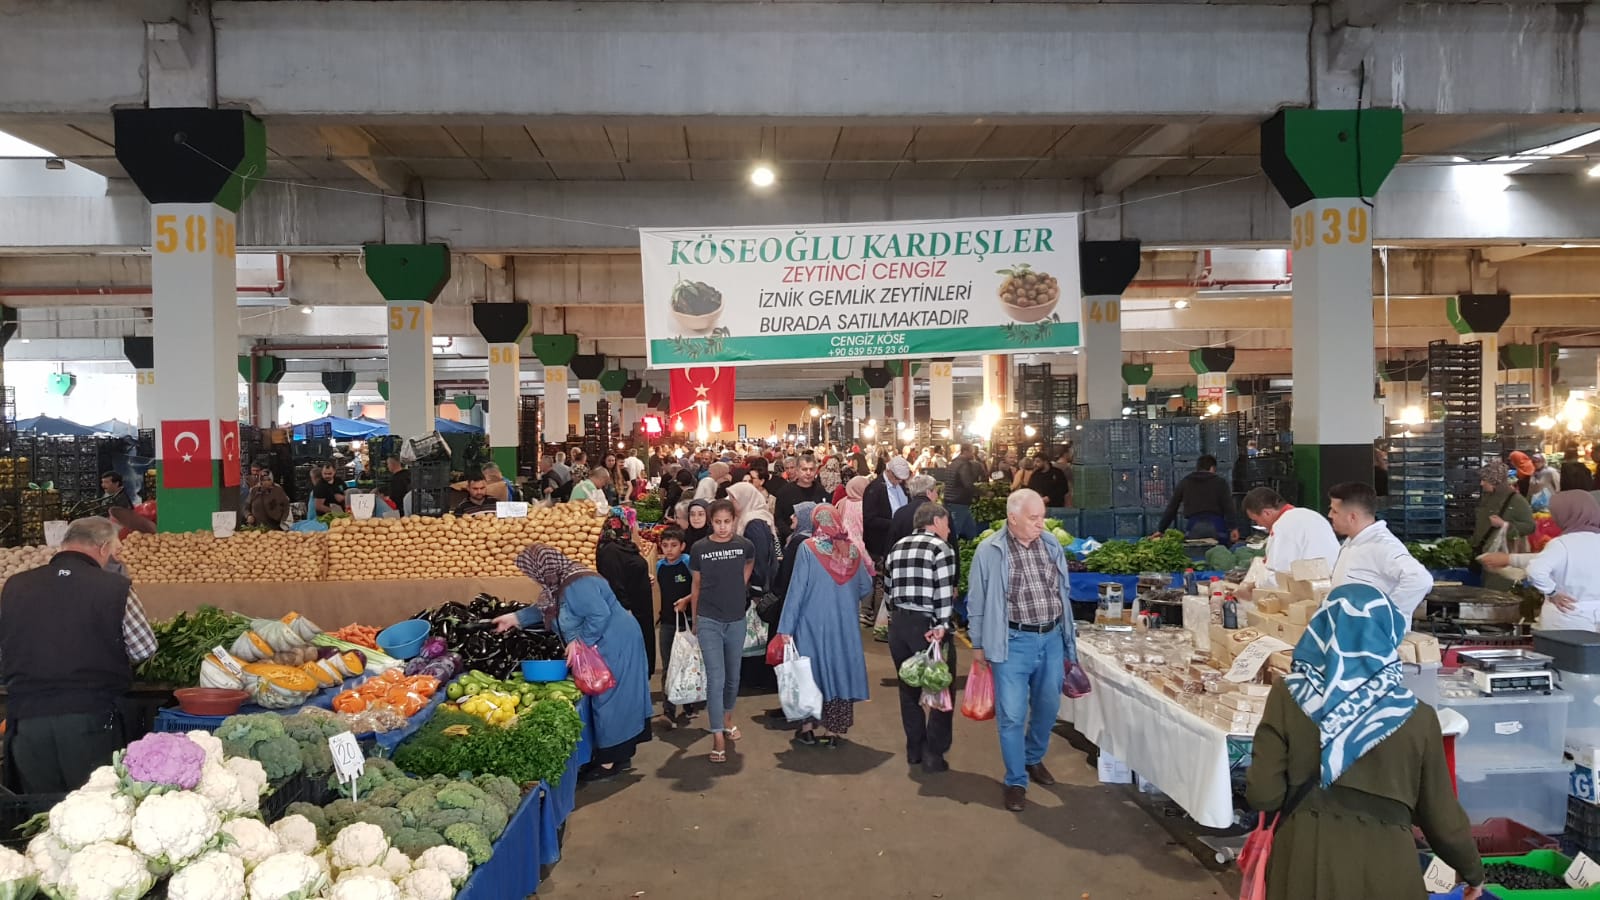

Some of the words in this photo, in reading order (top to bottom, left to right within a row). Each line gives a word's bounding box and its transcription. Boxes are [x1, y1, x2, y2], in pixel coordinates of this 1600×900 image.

[156, 214, 207, 253] 58
[1321, 207, 1367, 244] 39
[668, 231, 855, 265] KÖSEOĞLU
[861, 228, 1055, 262] KARDEŞLER
[782, 260, 866, 283] ZEYTİNCİ
[873, 257, 947, 279] CENGİZ
[759, 287, 804, 308] İZNİK
[808, 284, 876, 305] GEMLİK
[880, 281, 972, 303] ZEYTİNLERİ
[390, 306, 420, 331] 57
[760, 315, 831, 333] BURADA
[837, 309, 968, 330] SATILMAKTADIR
[1090, 301, 1118, 323] 40
[828, 347, 846, 357] +90
[848, 347, 865, 356] 539
[867, 346, 883, 355] 575
[885, 345, 896, 354] 23
[898, 345, 909, 354] 60
[830, 333, 875, 347] CENGİZ
[877, 332, 906, 345] KÖSE
[934, 365, 951, 377] 42
[335, 742, 356, 765] 20
